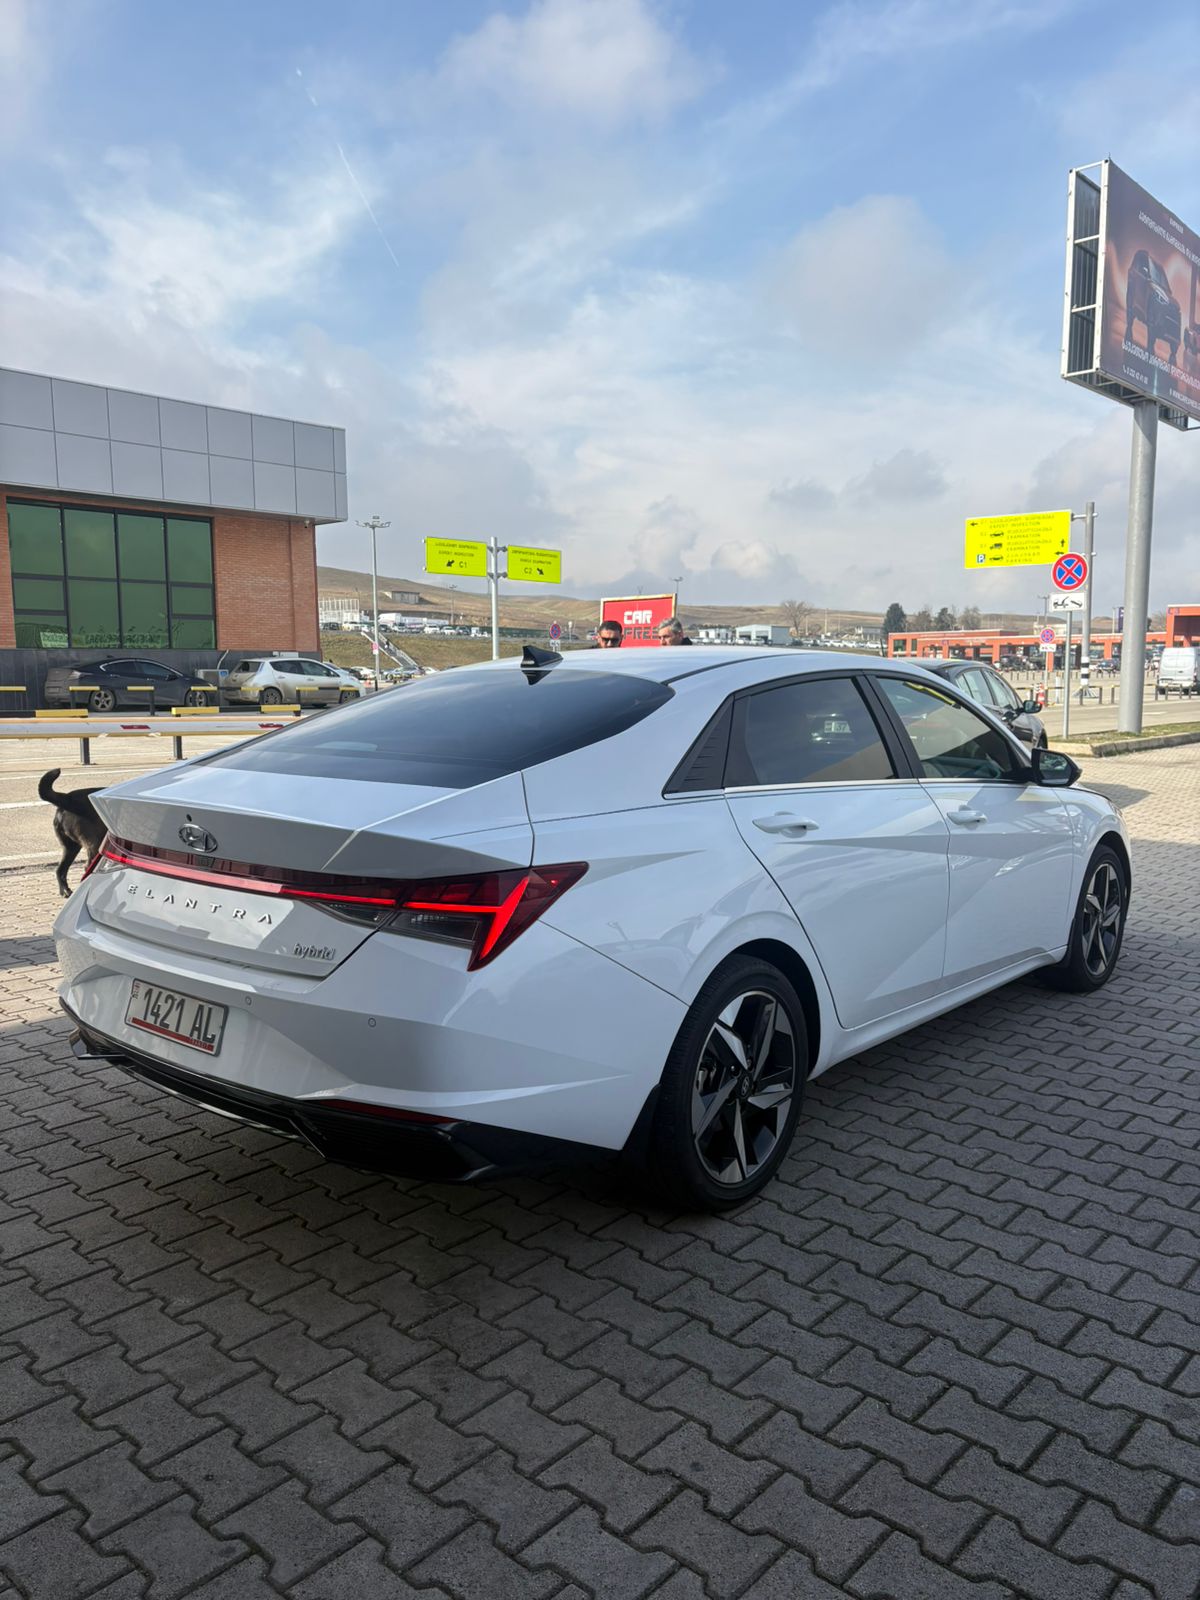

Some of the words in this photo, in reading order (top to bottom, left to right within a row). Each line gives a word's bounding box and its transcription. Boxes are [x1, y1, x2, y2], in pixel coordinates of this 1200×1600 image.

[459, 561, 467, 569] C1
[523, 567, 533, 575] C2
[623, 609, 653, 625] CAR
[127, 883, 273, 925] ELANTRA
[293, 943, 336, 960] hybrid
[143, 987, 186, 1033] 1421
[189, 1003, 217, 1044] AL
